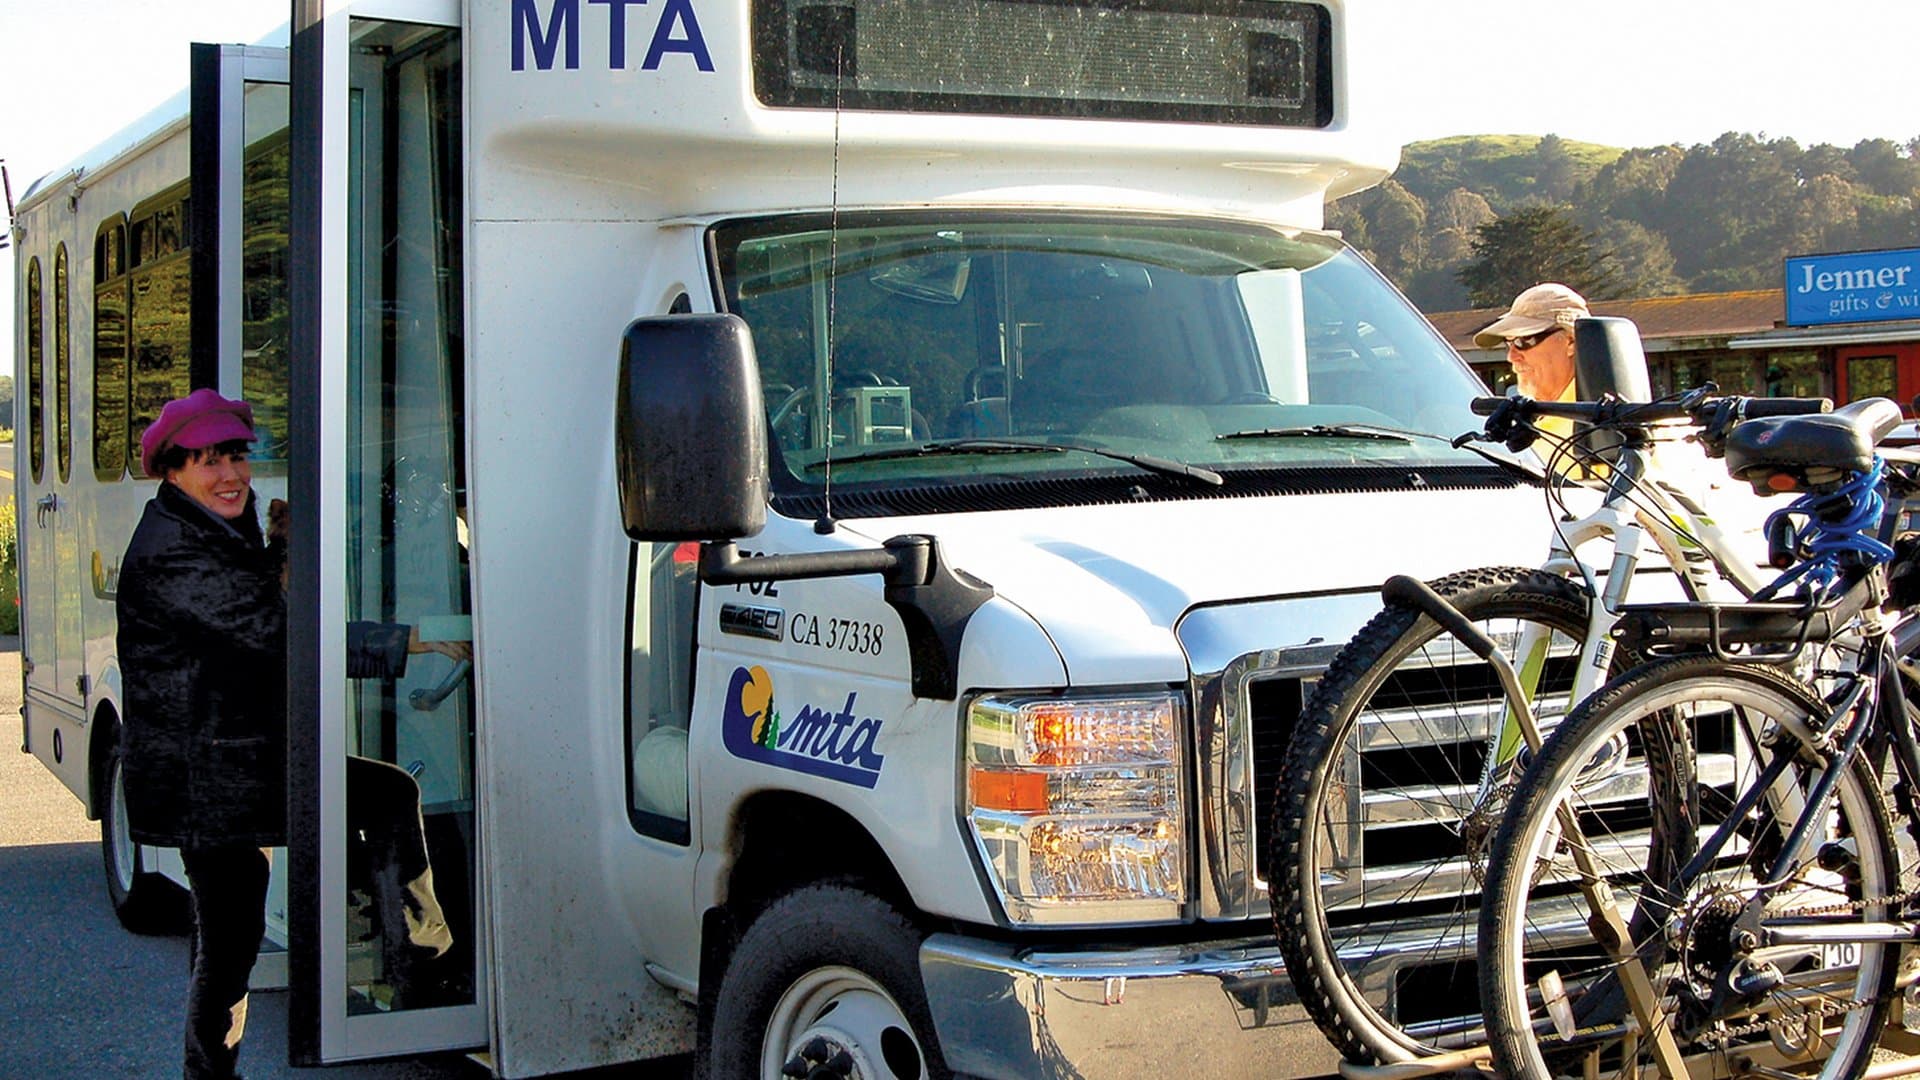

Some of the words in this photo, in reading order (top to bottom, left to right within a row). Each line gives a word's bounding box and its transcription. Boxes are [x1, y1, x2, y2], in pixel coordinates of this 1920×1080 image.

[511, 0, 716, 73] MTA
[1798, 264, 1911, 294] Jenner
[1829, 293, 1869, 316] gifts
[1875, 291, 1894, 309] &
[791, 613, 821, 647] CA
[826, 618, 884, 656] 37338
[777, 692, 885, 771] mta
